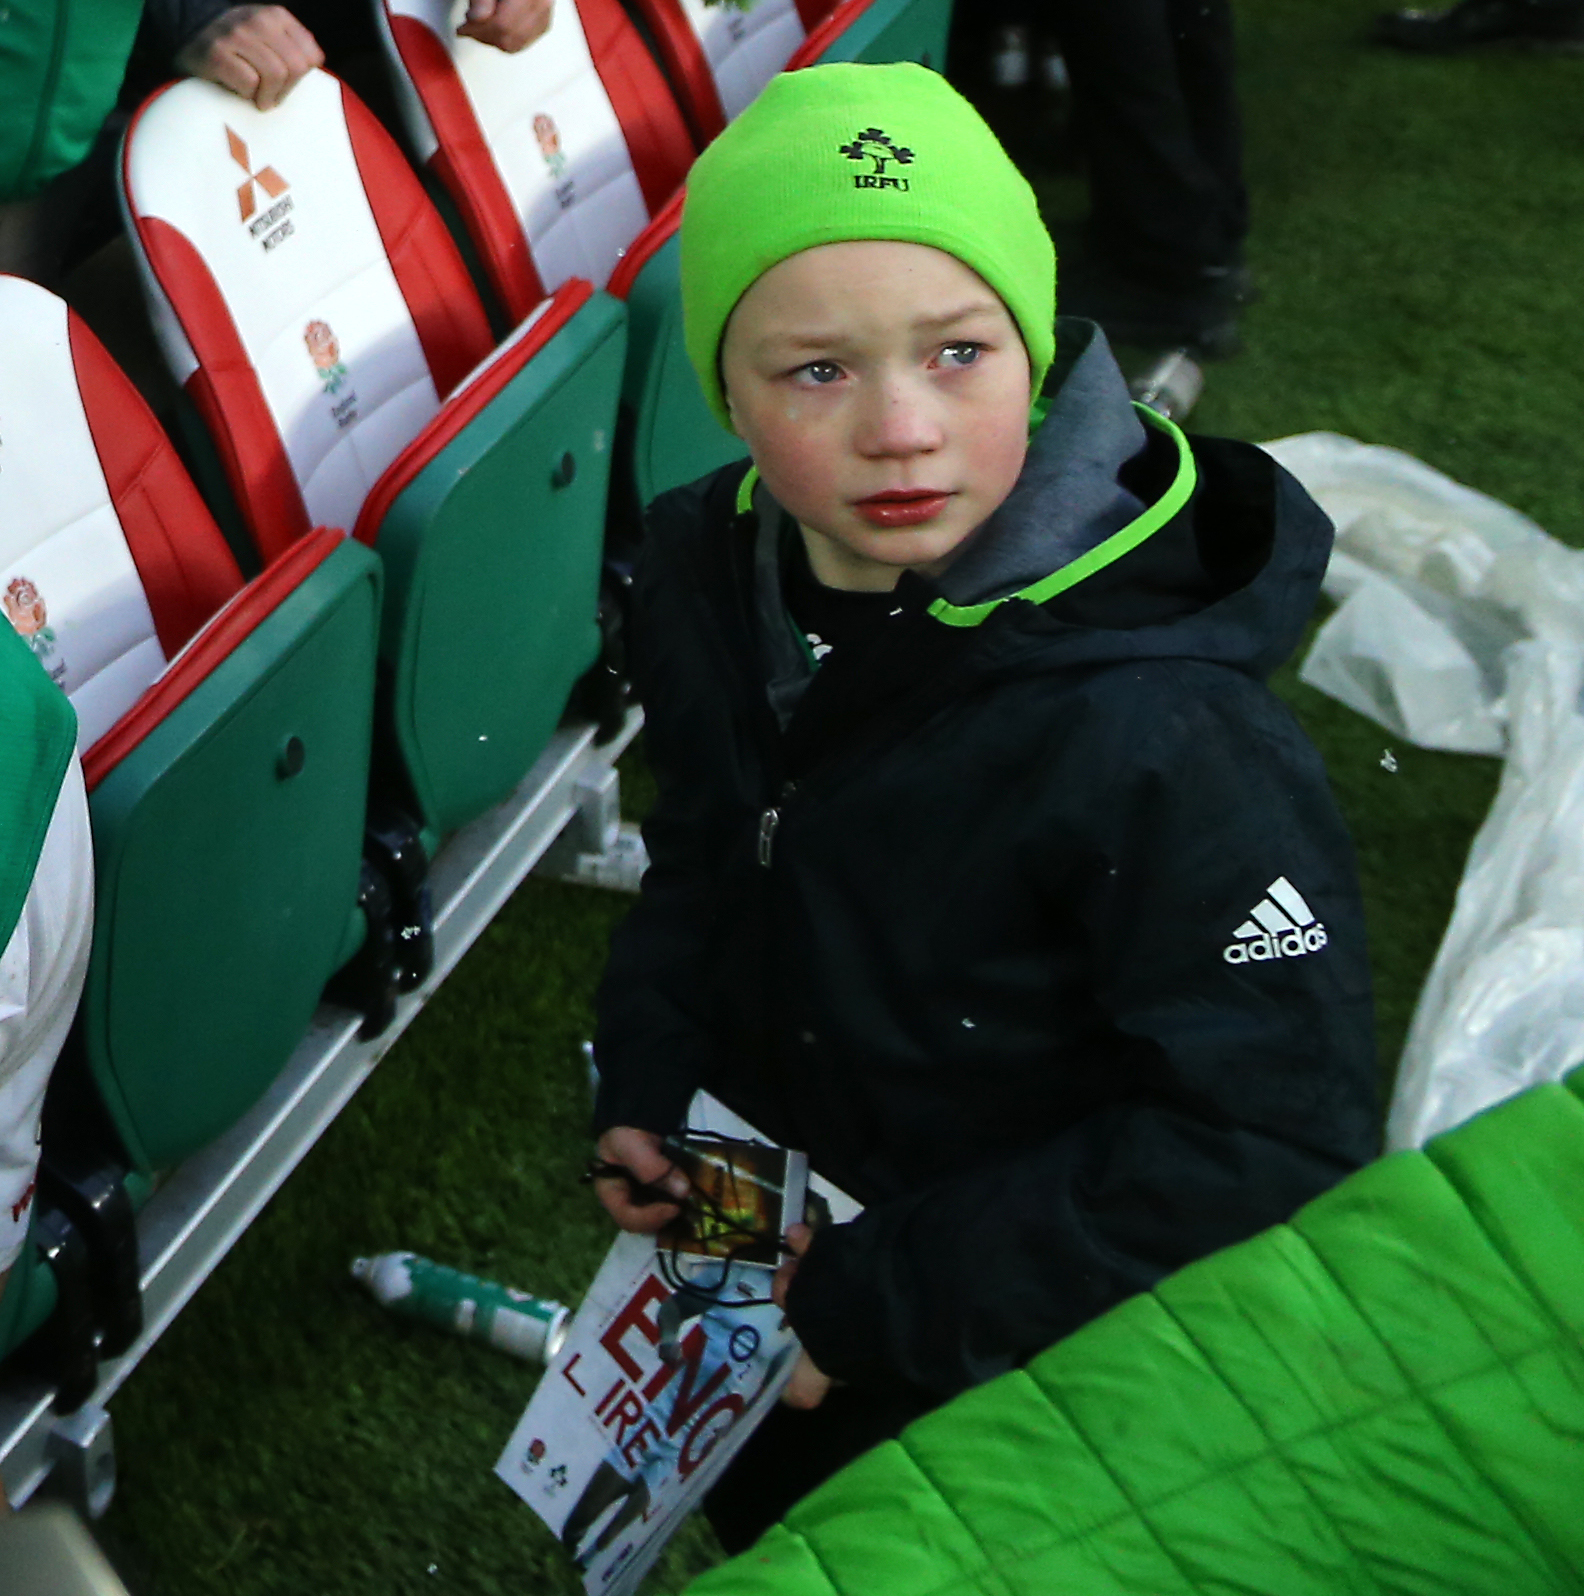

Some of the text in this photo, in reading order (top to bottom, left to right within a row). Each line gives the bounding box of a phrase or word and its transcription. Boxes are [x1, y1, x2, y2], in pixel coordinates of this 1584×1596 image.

[853, 174, 910, 193] IRFU
[1222, 922, 1329, 965] adidas
[599, 1272, 745, 1486] ENG
